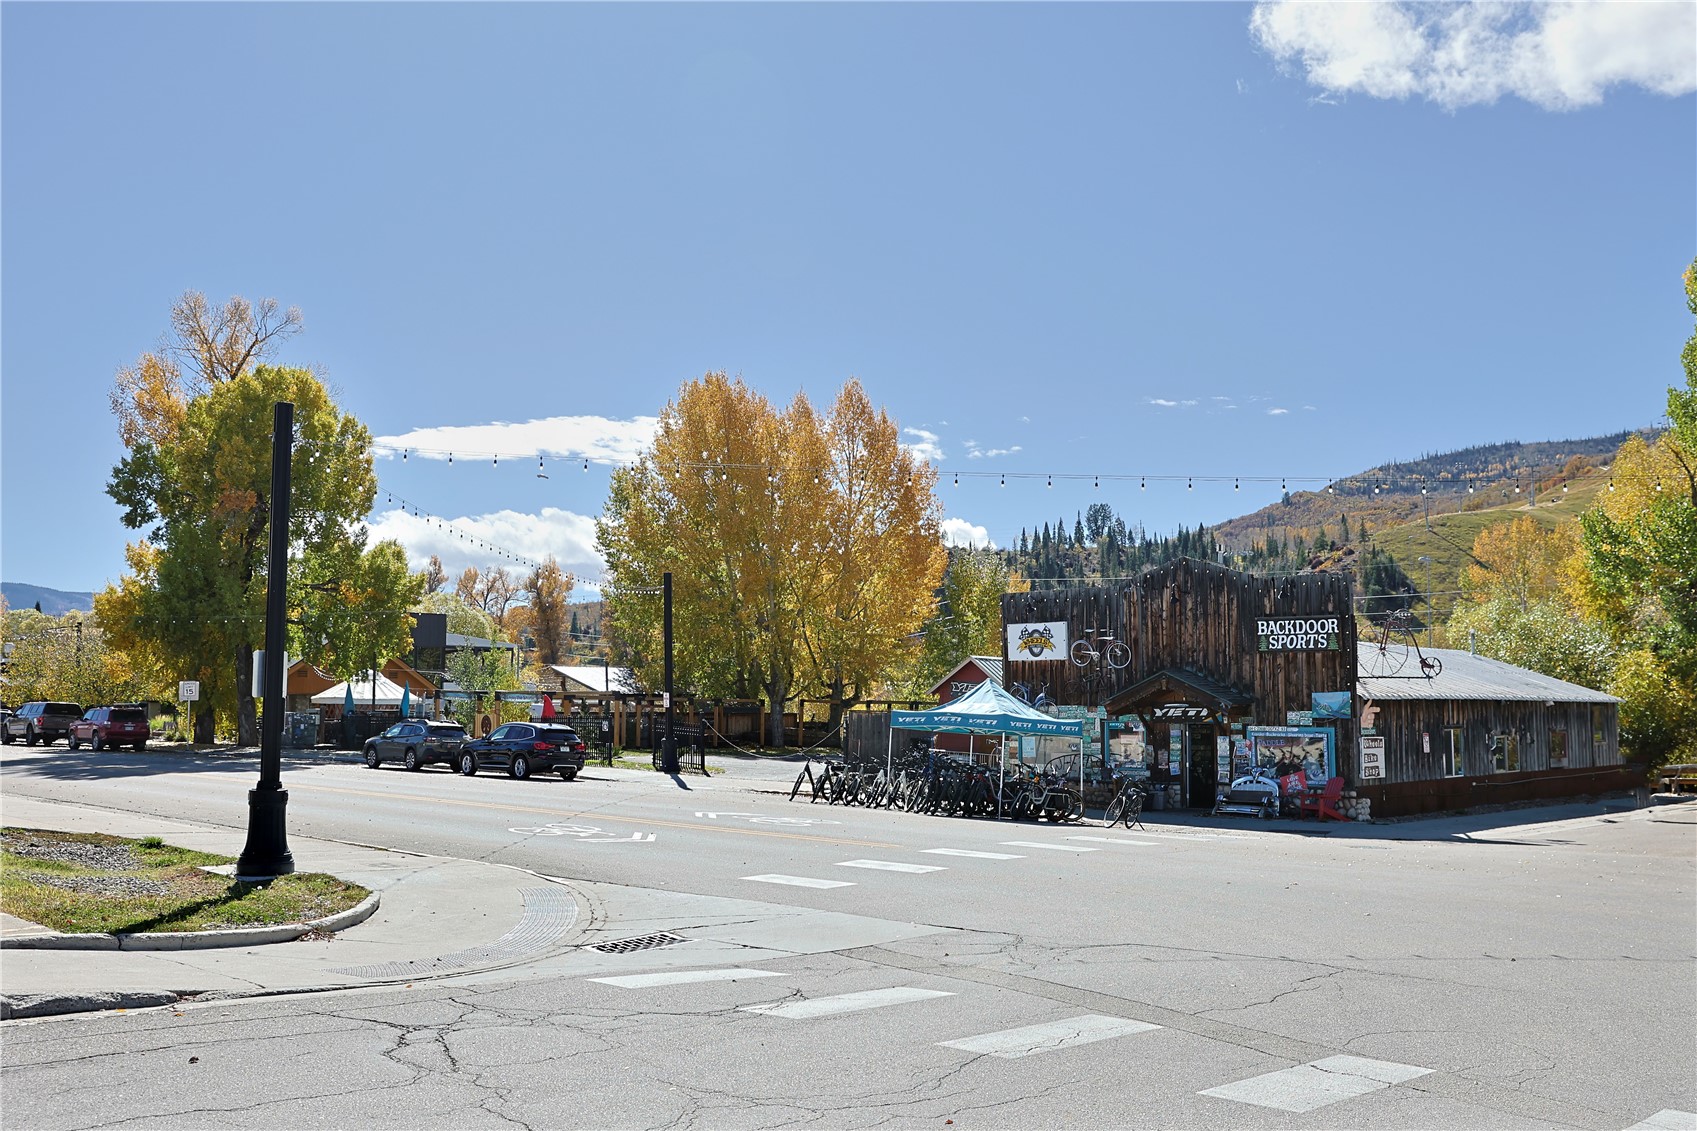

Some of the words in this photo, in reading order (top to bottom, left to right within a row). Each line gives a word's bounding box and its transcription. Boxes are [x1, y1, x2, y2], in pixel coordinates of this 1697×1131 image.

[1257, 619, 1339, 635] BACKDOOR
[1269, 634, 1327, 649] SPORTS
[1153, 707, 1209, 717] YETI
